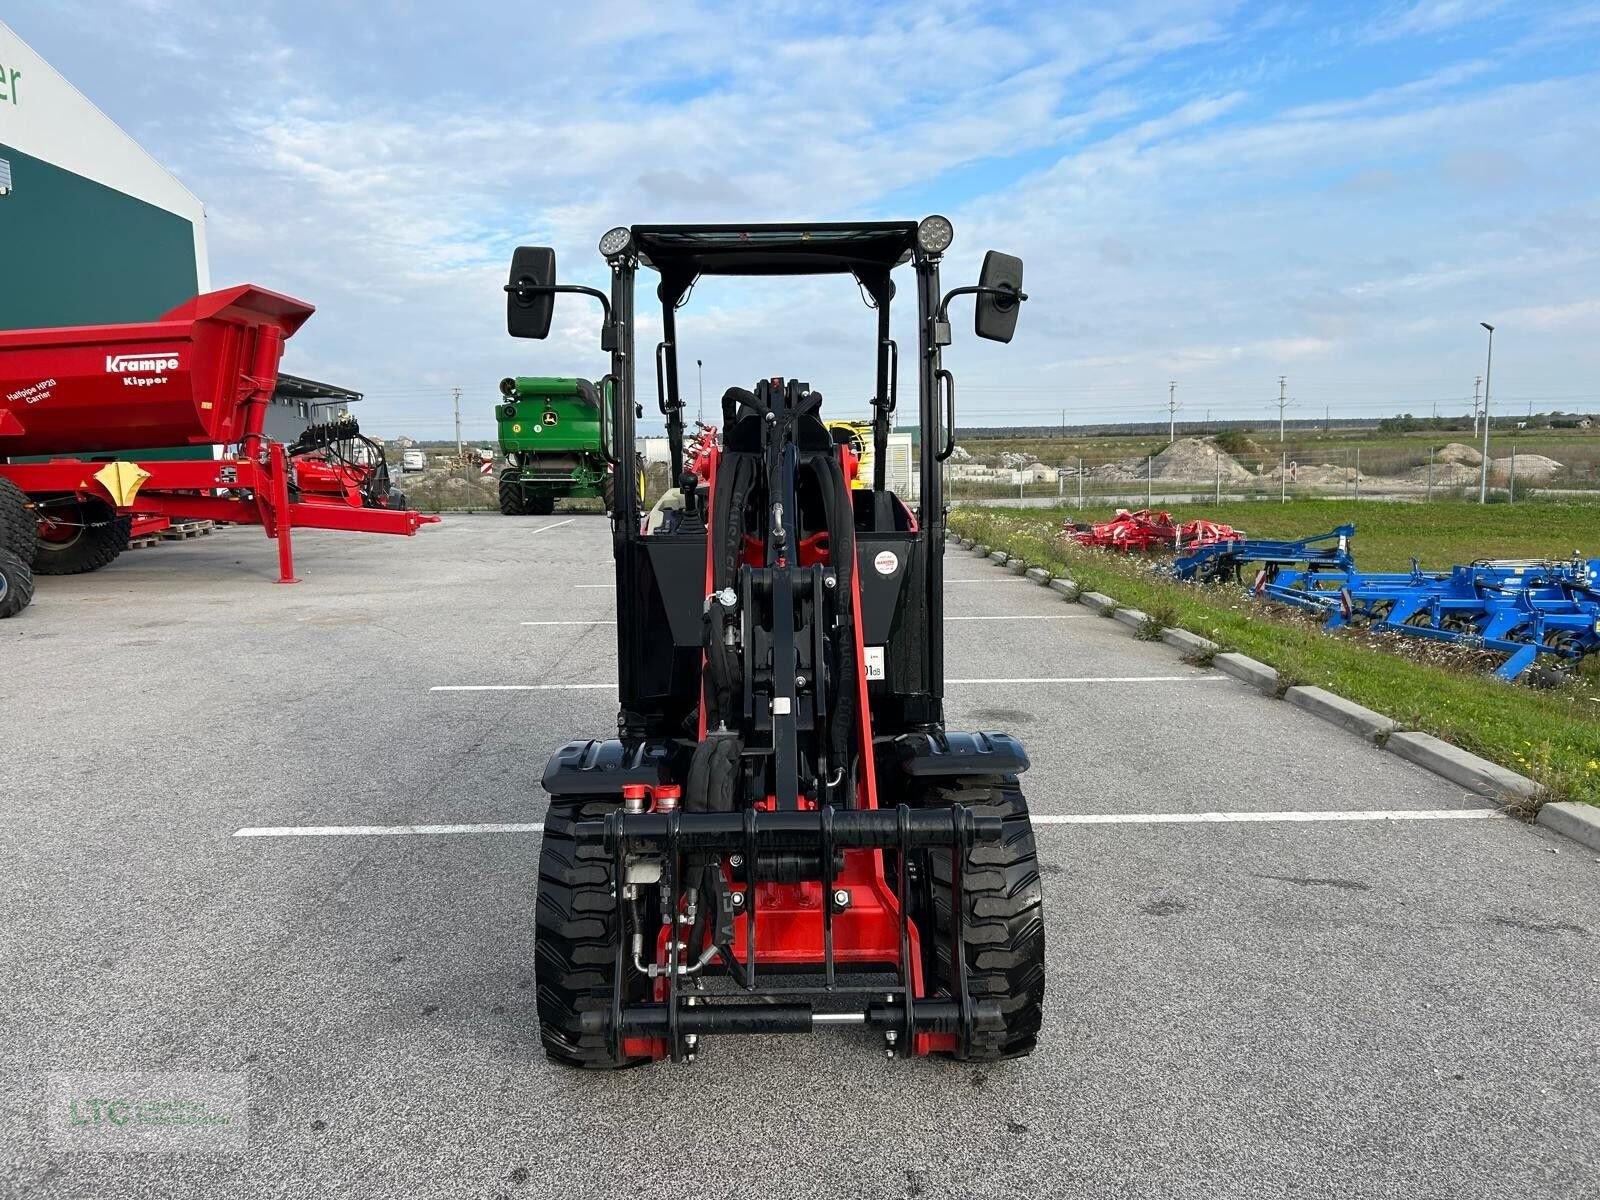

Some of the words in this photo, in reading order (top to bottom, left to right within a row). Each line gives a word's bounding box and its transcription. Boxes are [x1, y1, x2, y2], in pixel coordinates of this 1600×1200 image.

[106, 353, 179, 373] Krampe
[123, 376, 168, 386] Kipper
[6, 387, 37, 401] Halfpipe
[36, 379, 56, 390] HP20
[26, 391, 50, 403] Carrier
